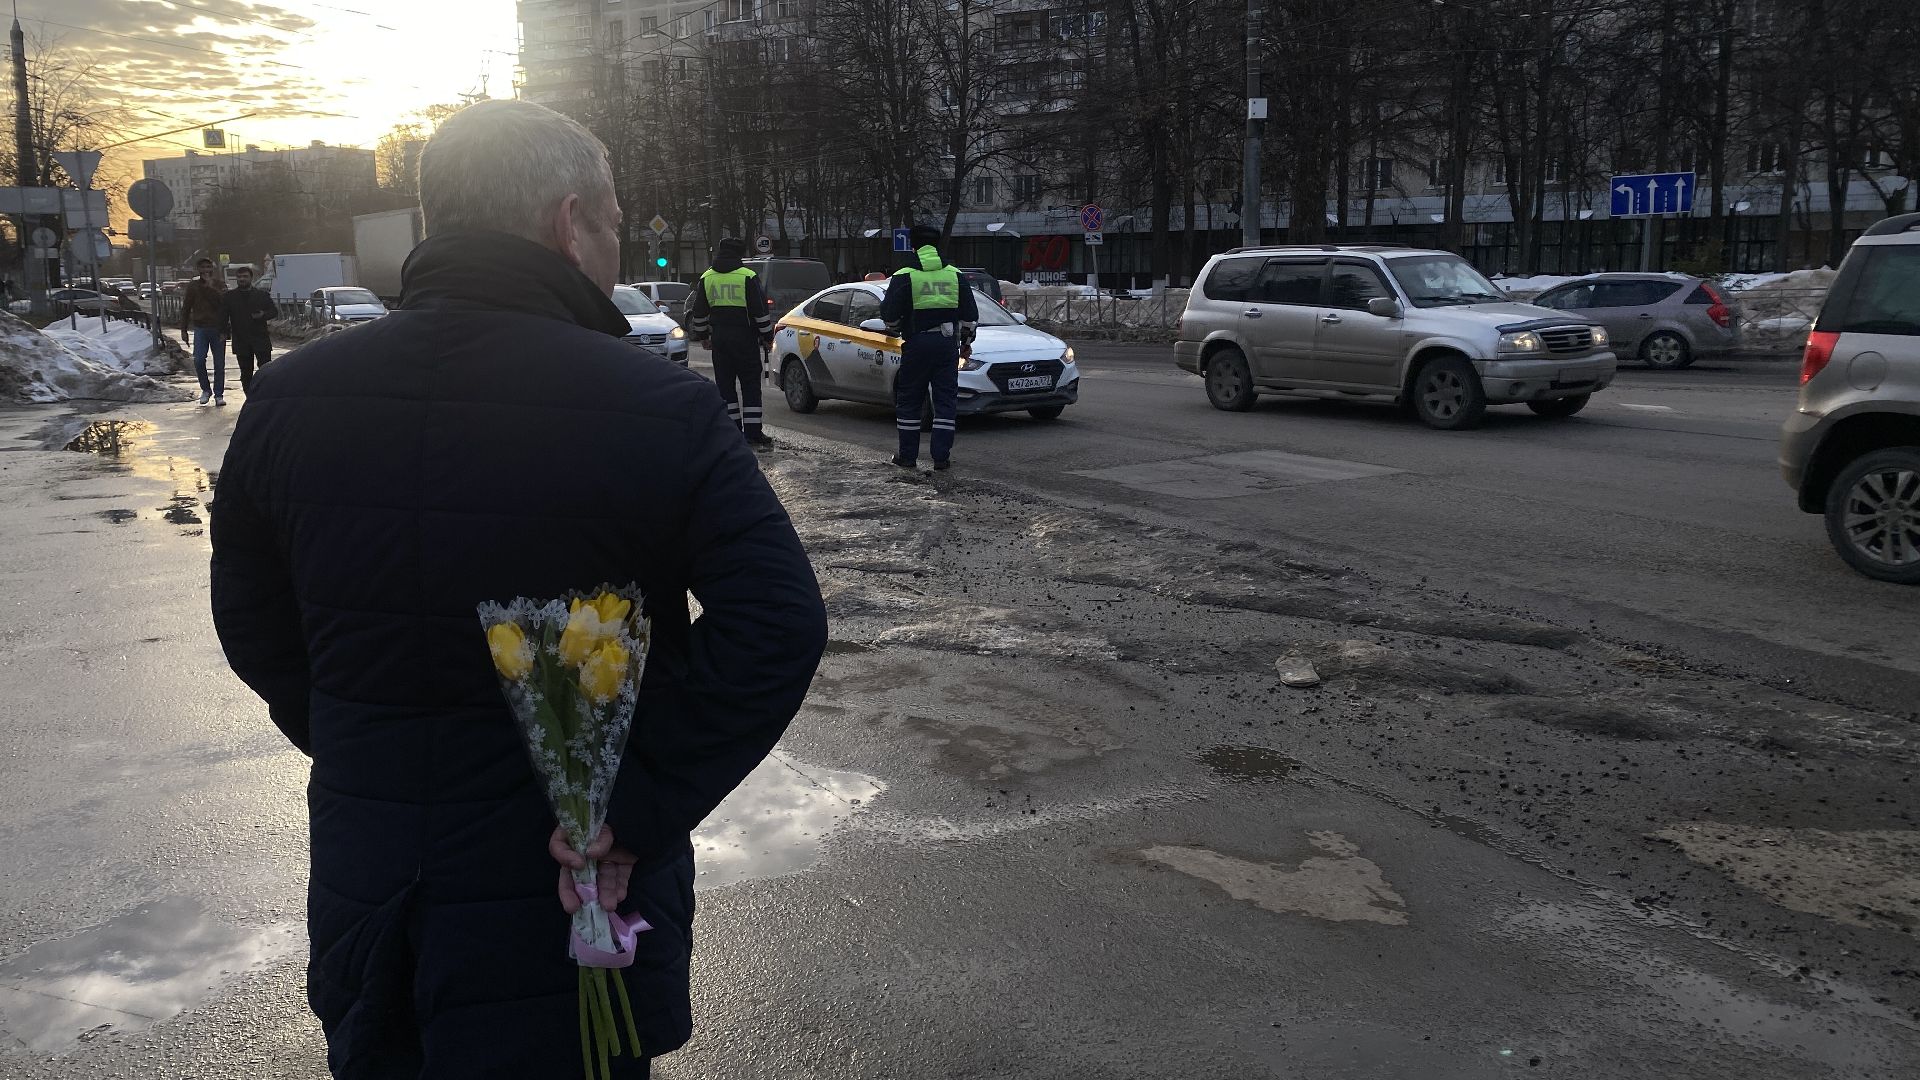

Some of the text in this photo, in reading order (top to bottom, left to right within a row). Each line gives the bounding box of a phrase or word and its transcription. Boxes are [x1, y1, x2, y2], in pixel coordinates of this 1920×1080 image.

[1022, 235, 1070, 270] 50
[1024, 271, 1067, 281] ВИДНОЕ
[709, 284, 743, 302] ДПС
[919, 281, 952, 295] ДПС
